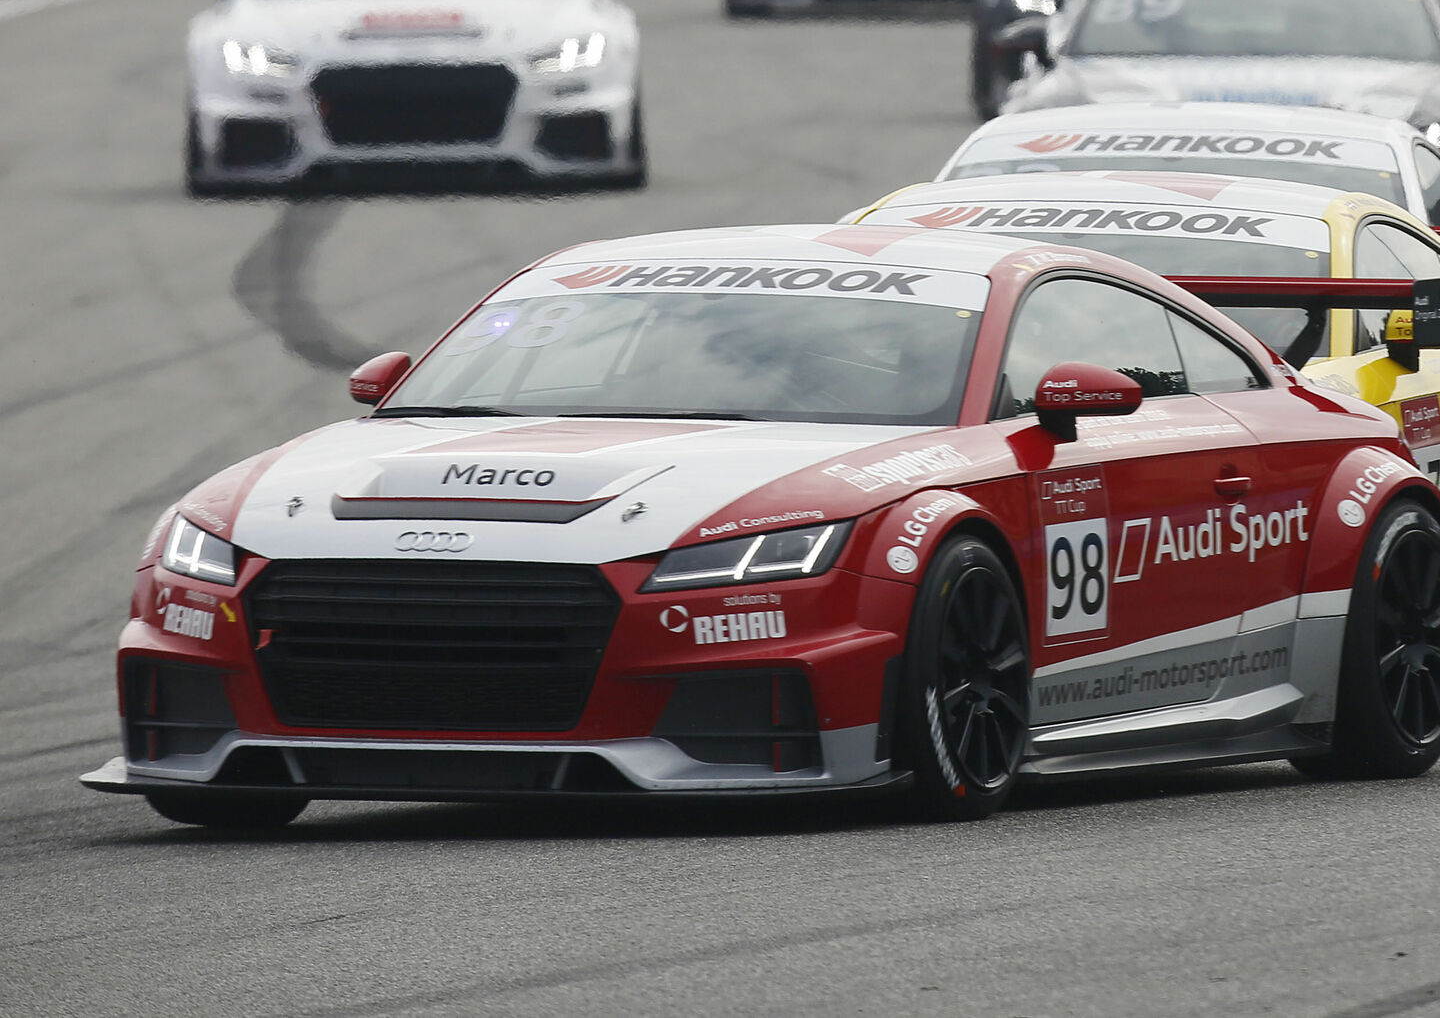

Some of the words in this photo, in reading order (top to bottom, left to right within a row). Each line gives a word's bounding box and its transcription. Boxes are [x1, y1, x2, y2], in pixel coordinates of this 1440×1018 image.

[1041, 380, 1078, 389] Audi
[1045, 390, 1071, 403] Top
[1073, 389, 1123, 402] Service
[441, 463, 556, 487] Marco
[1052, 480, 1074, 495] Audi
[1349, 477, 1377, 504] LG
[700, 522, 738, 538] Audi
[740, 508, 825, 529] Consulting
[897, 519, 928, 548] LG
[1154, 509, 1222, 565] Audi
[1229, 500, 1310, 563] Sport
[1051, 532, 1105, 621] 98
[163, 602, 215, 641] REHAU
[693, 610, 787, 644] REHAU
[1037, 645, 1289, 708] www.audi-motorsport.com
